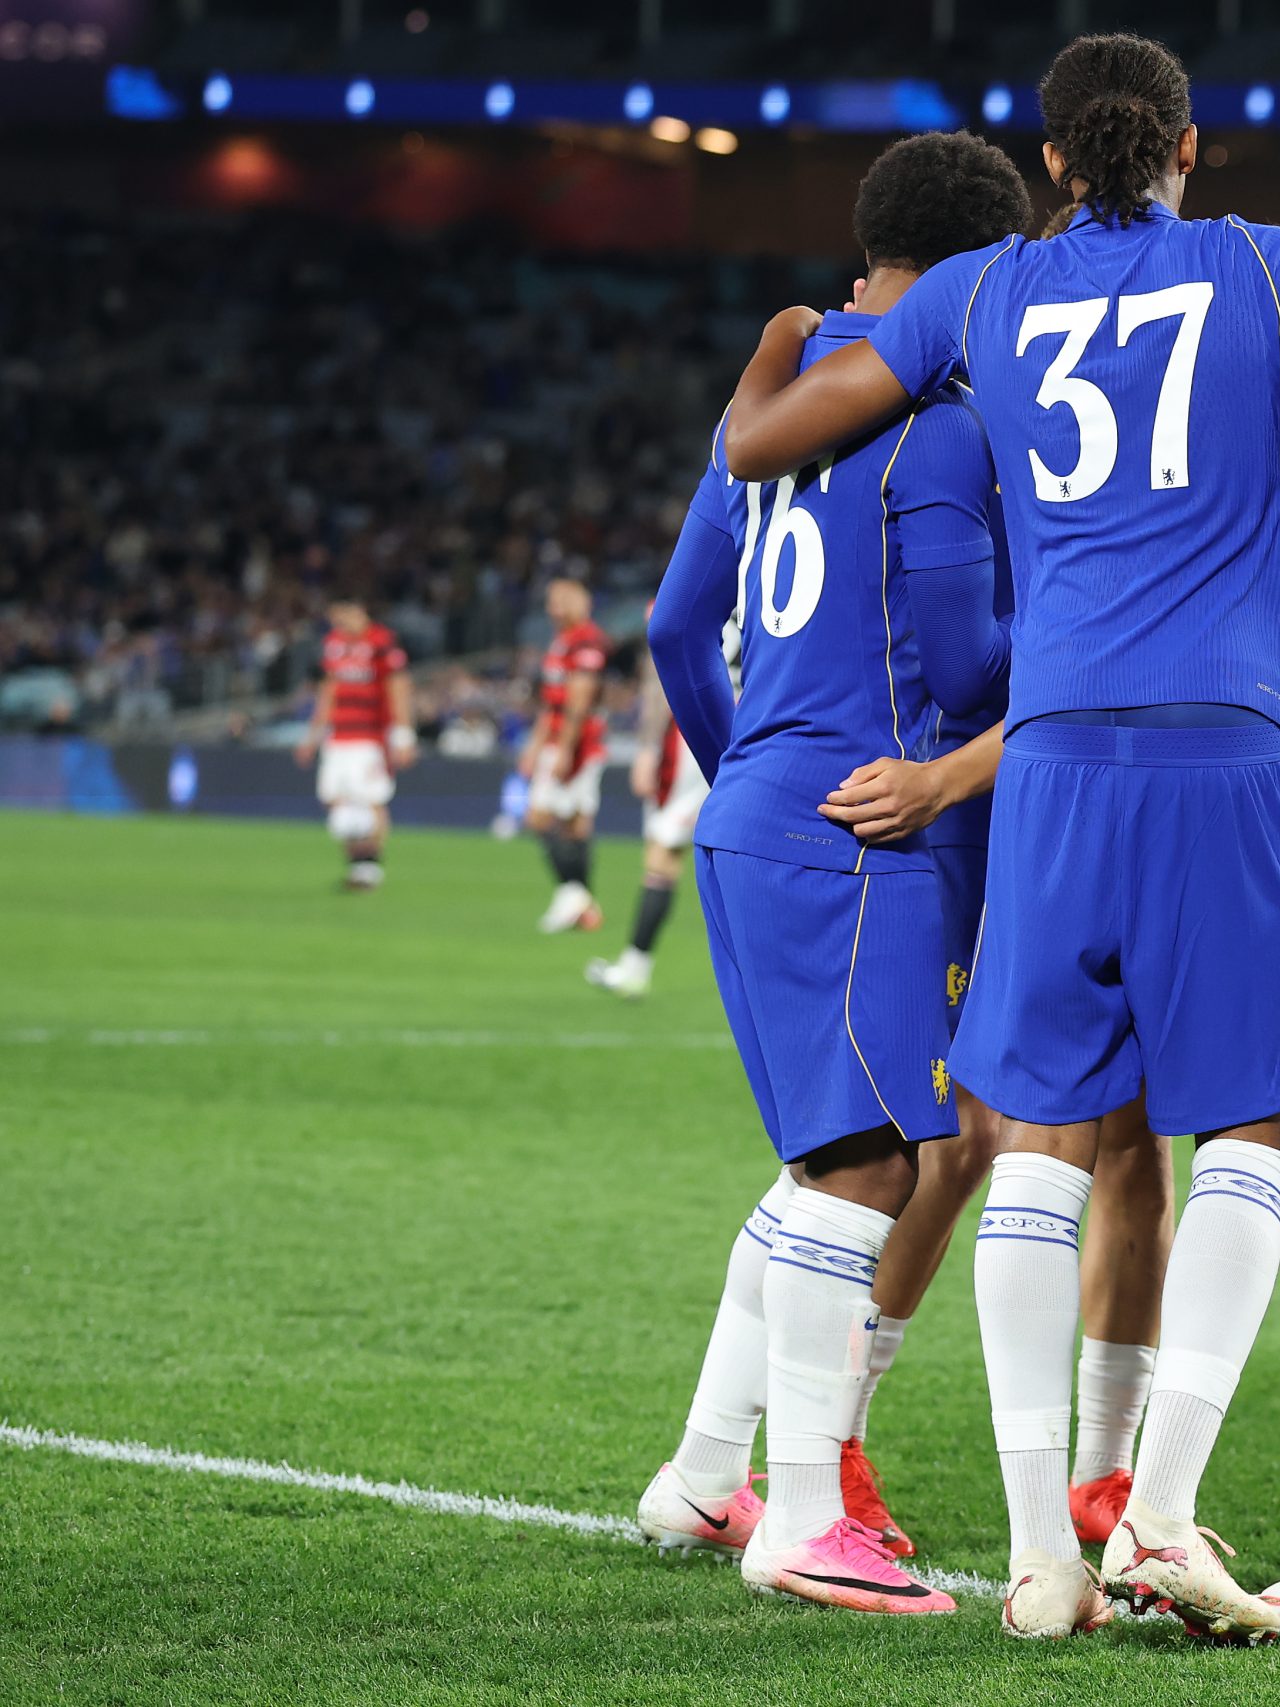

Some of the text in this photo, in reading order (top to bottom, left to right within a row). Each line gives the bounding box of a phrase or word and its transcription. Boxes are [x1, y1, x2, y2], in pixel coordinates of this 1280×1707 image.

[1016, 281, 1214, 503] 37
[784, 832, 834, 846] AERO-FIT
[1000, 1217, 1057, 1231] CFC
